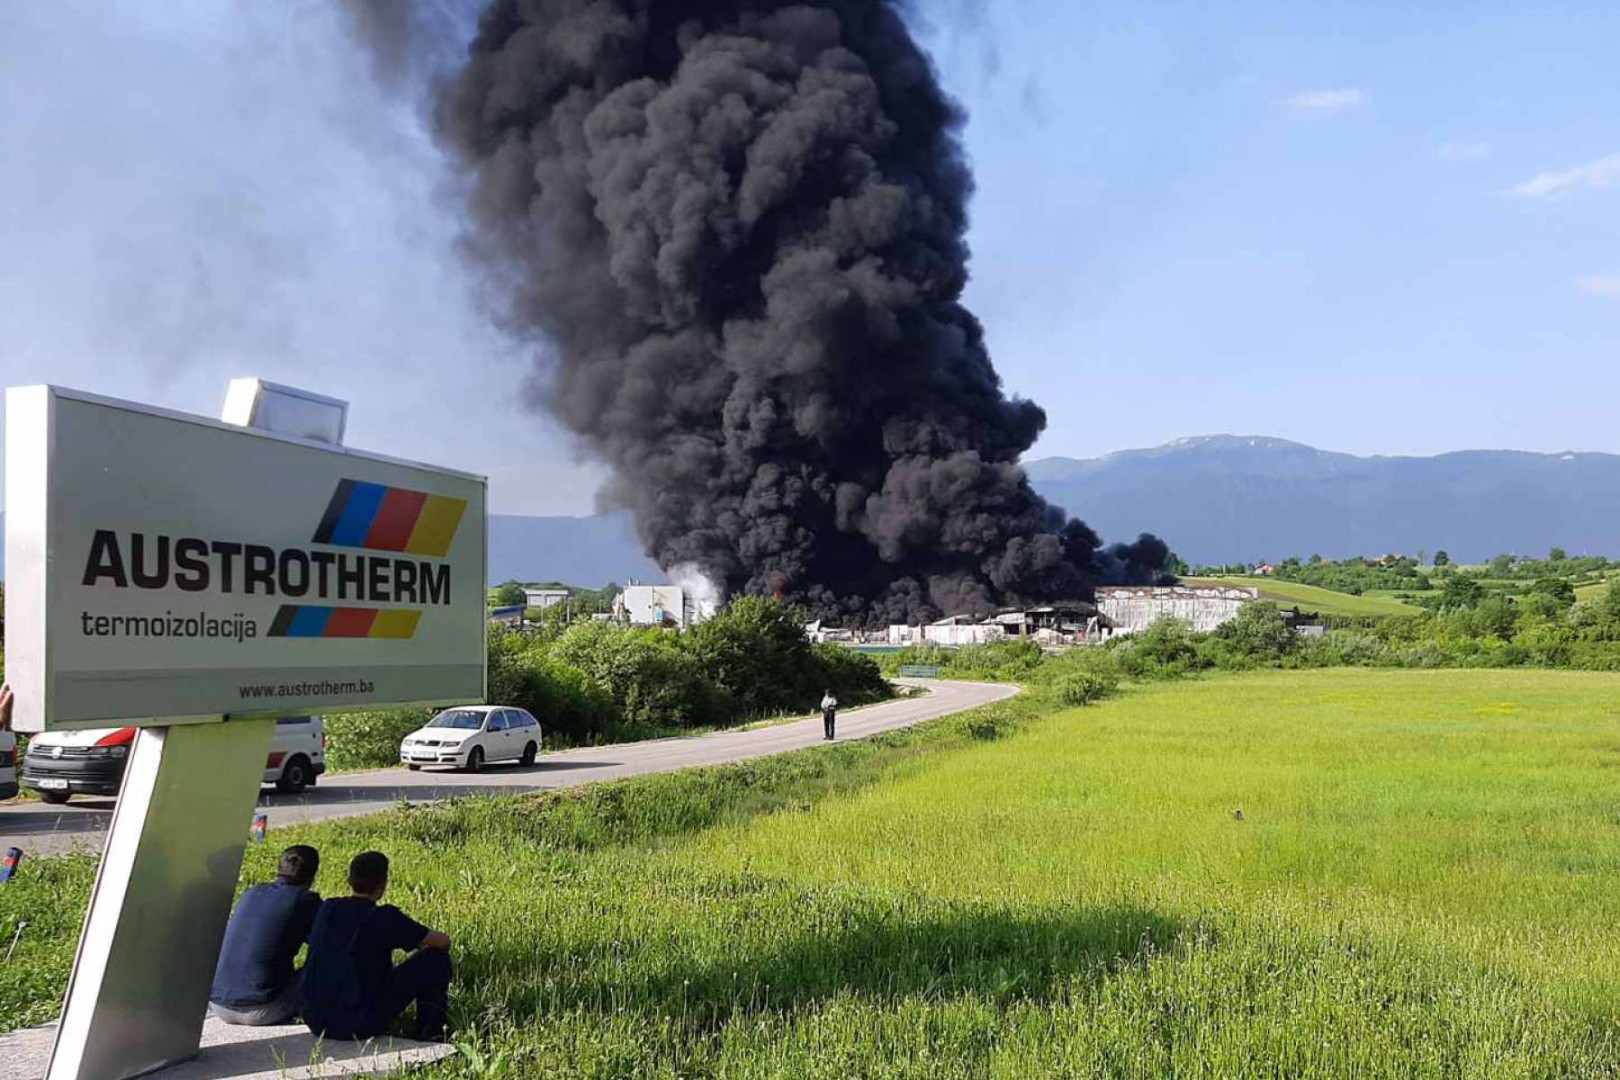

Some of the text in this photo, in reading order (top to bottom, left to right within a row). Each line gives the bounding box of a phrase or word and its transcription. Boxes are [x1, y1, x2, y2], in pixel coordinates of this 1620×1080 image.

[82, 529, 451, 605] AUSTROTHERM
[81, 610, 257, 643] termoizolacija
[239, 679, 374, 698] www.austrotherm.ba
